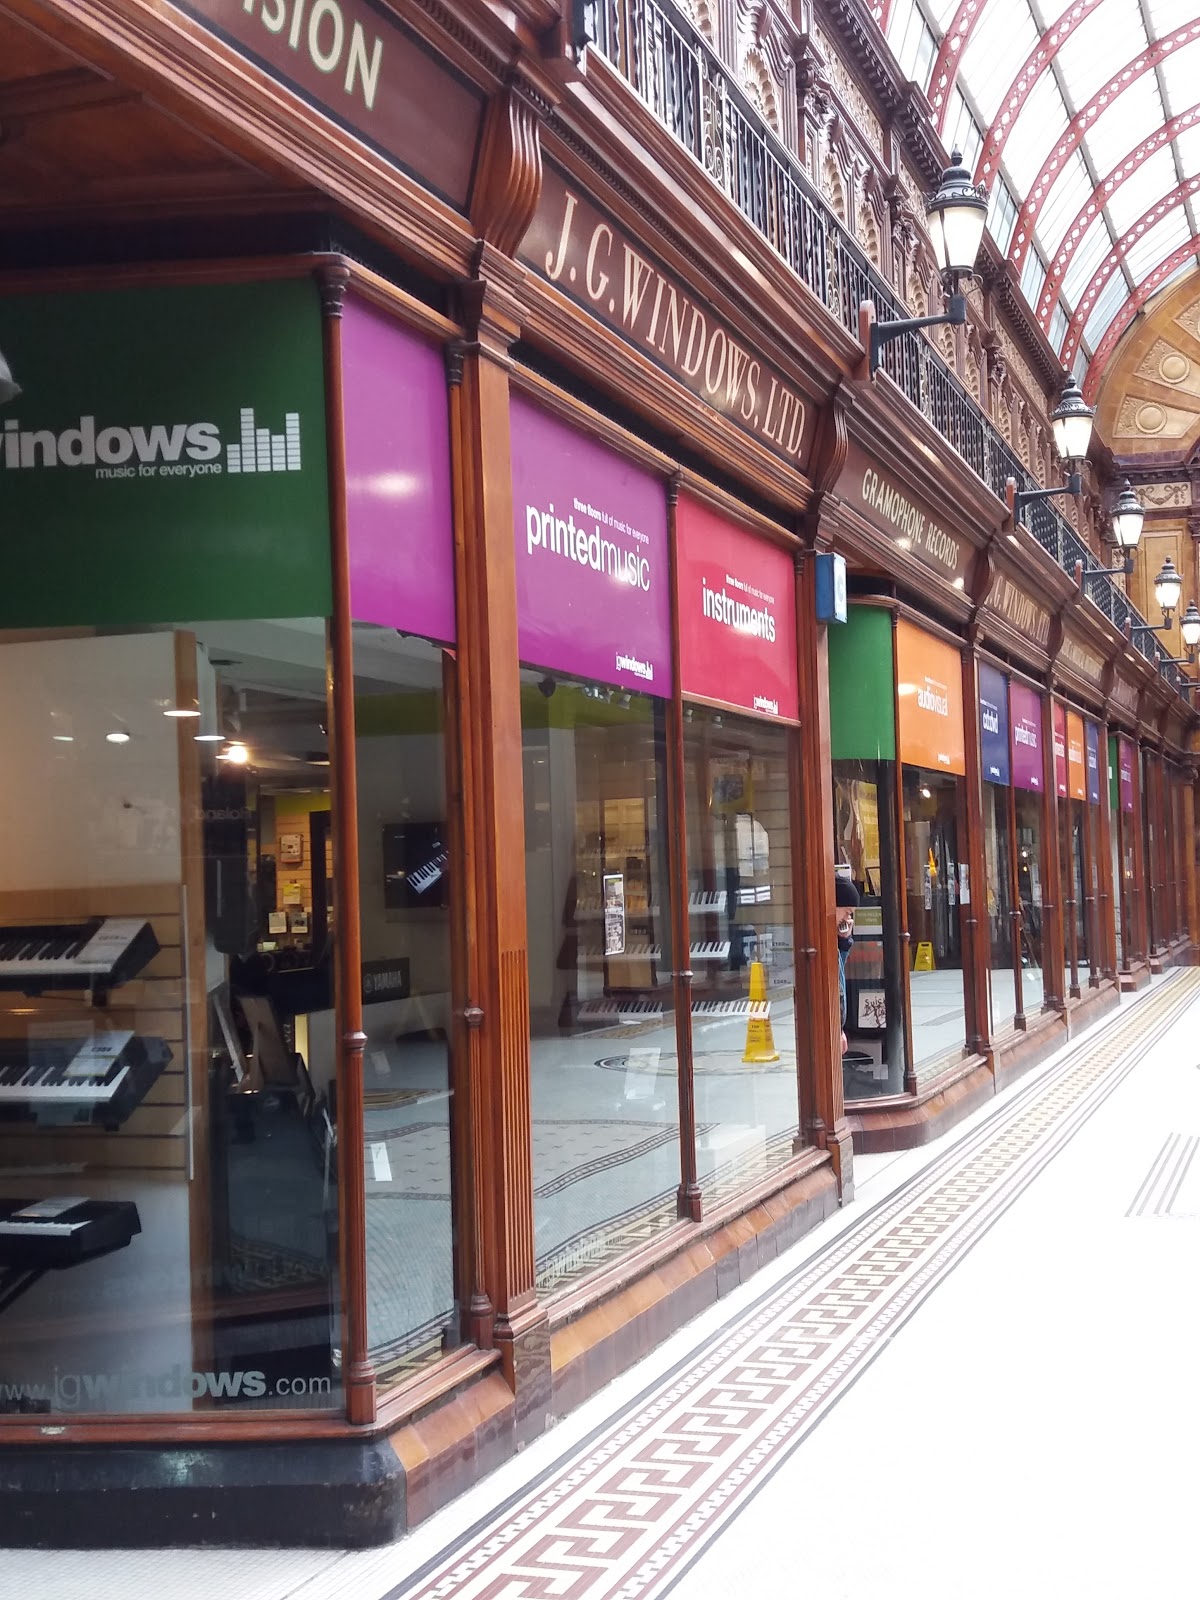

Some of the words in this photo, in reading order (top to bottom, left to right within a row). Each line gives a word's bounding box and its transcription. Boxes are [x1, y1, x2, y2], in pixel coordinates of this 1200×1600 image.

[244, 0, 383, 110] SION
[0, 415, 222, 469] indows
[95, 466, 135, 479] music
[138, 463, 156, 476] for
[159, 461, 223, 478] everyone
[526, 502, 650, 591] printedmusic
[862, 468, 925, 544] GRAMOPHONE
[925, 521, 960, 570] RECORDS
[702, 576, 776, 643] instruments
[0, 1365, 331, 1409] ww.jgwindows.com
